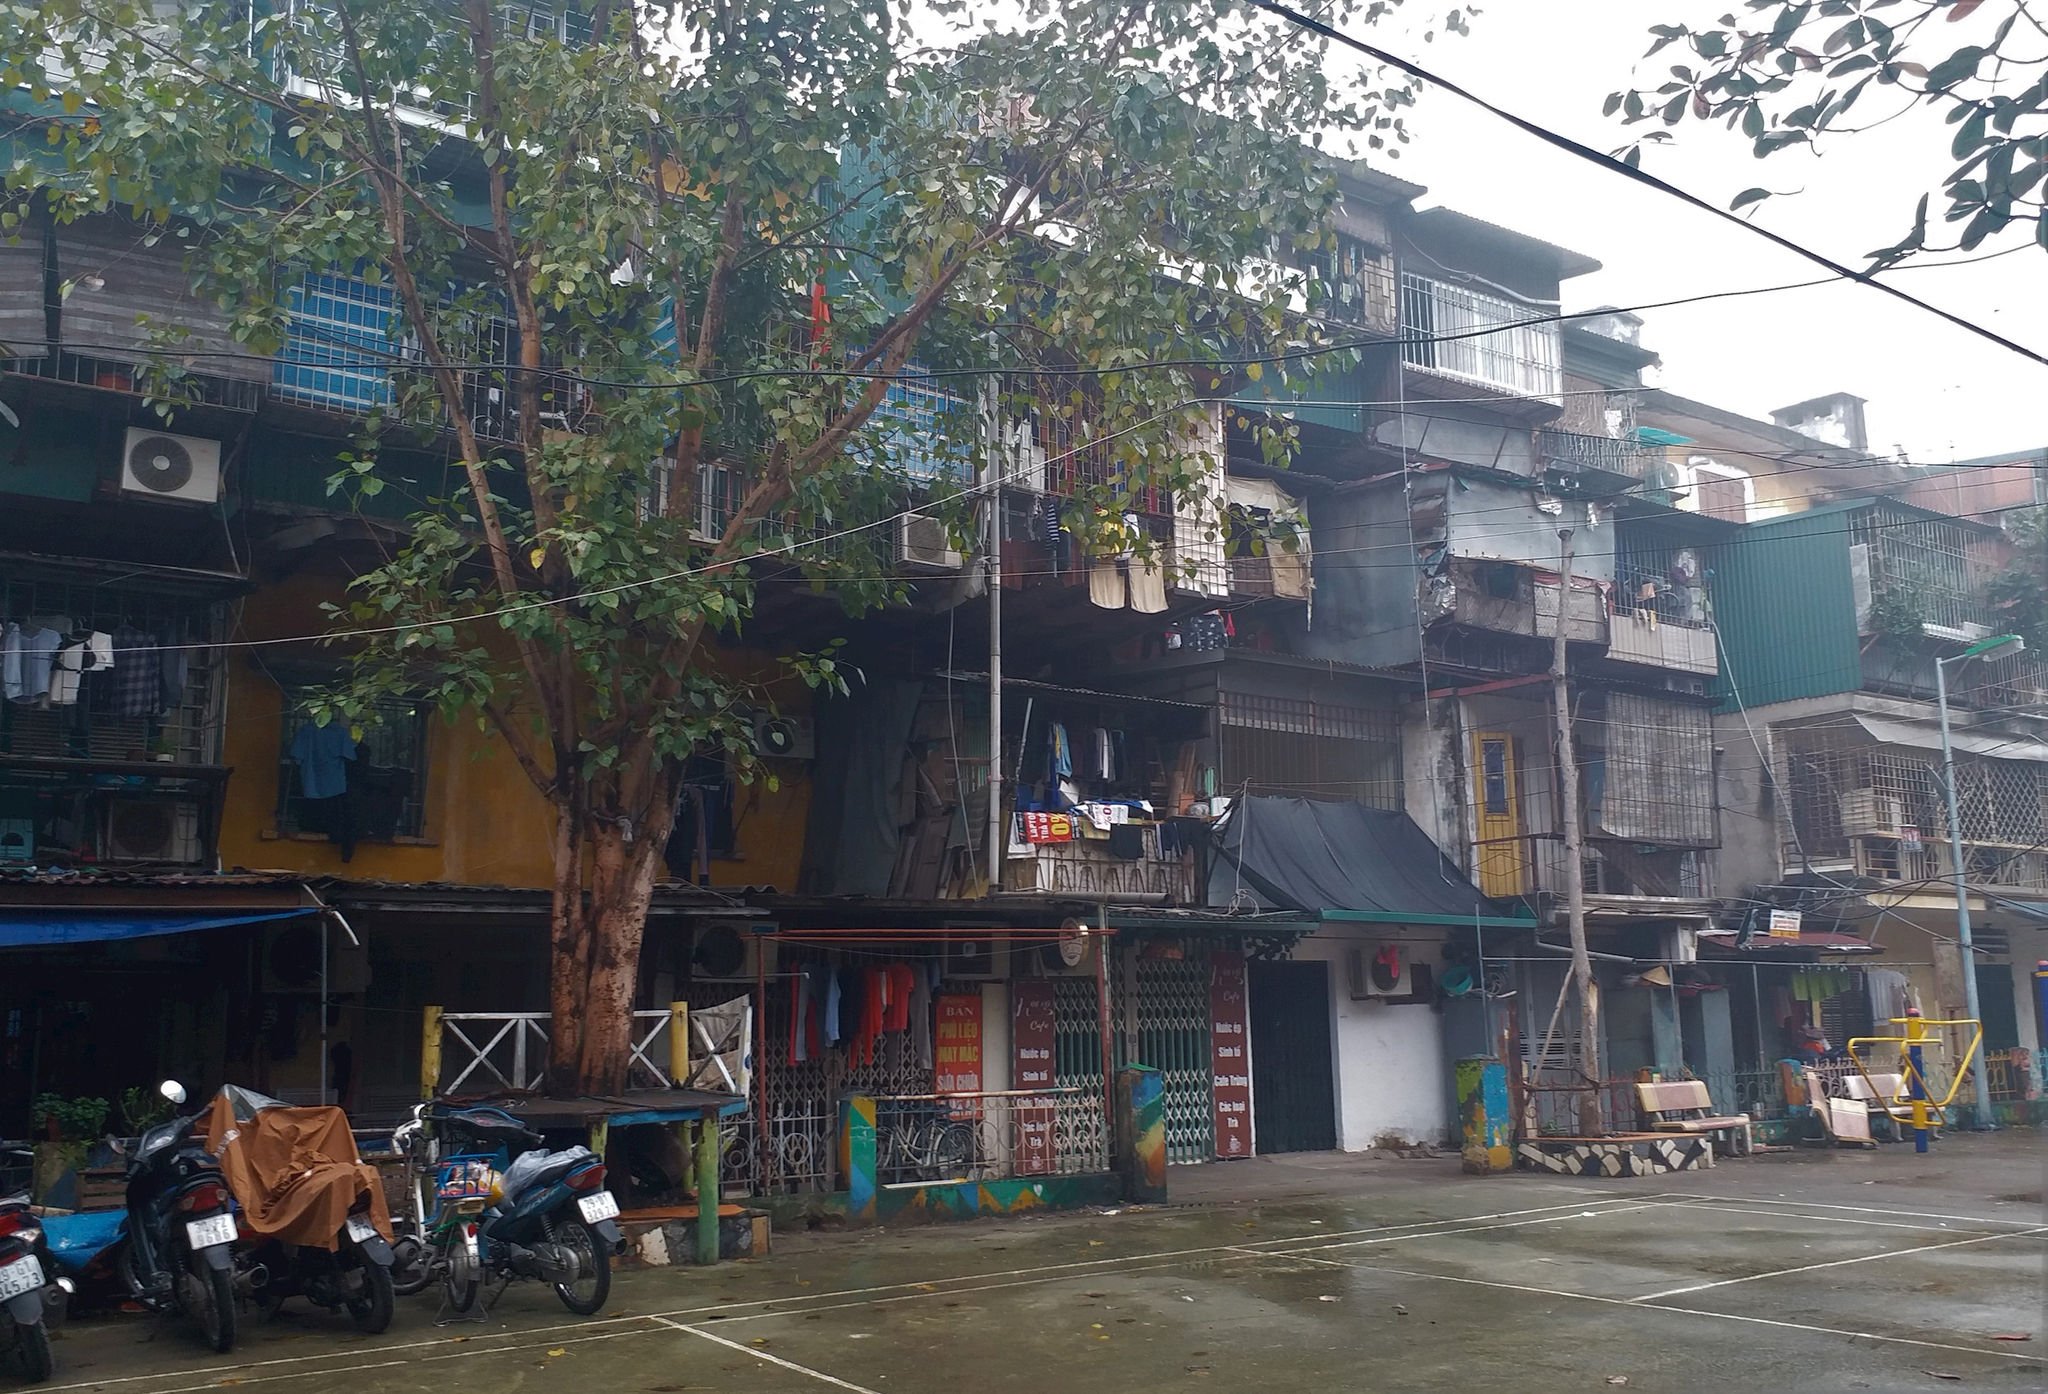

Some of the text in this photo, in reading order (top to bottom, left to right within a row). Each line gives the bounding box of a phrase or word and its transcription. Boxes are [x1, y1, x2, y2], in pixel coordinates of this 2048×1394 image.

[1218, 1046, 1233, 1058] Sinh
[1022, 1071, 1039, 1082] Sinh
[1218, 1101, 1232, 1113] Các
[1227, 1116, 1239, 1128] Trà
